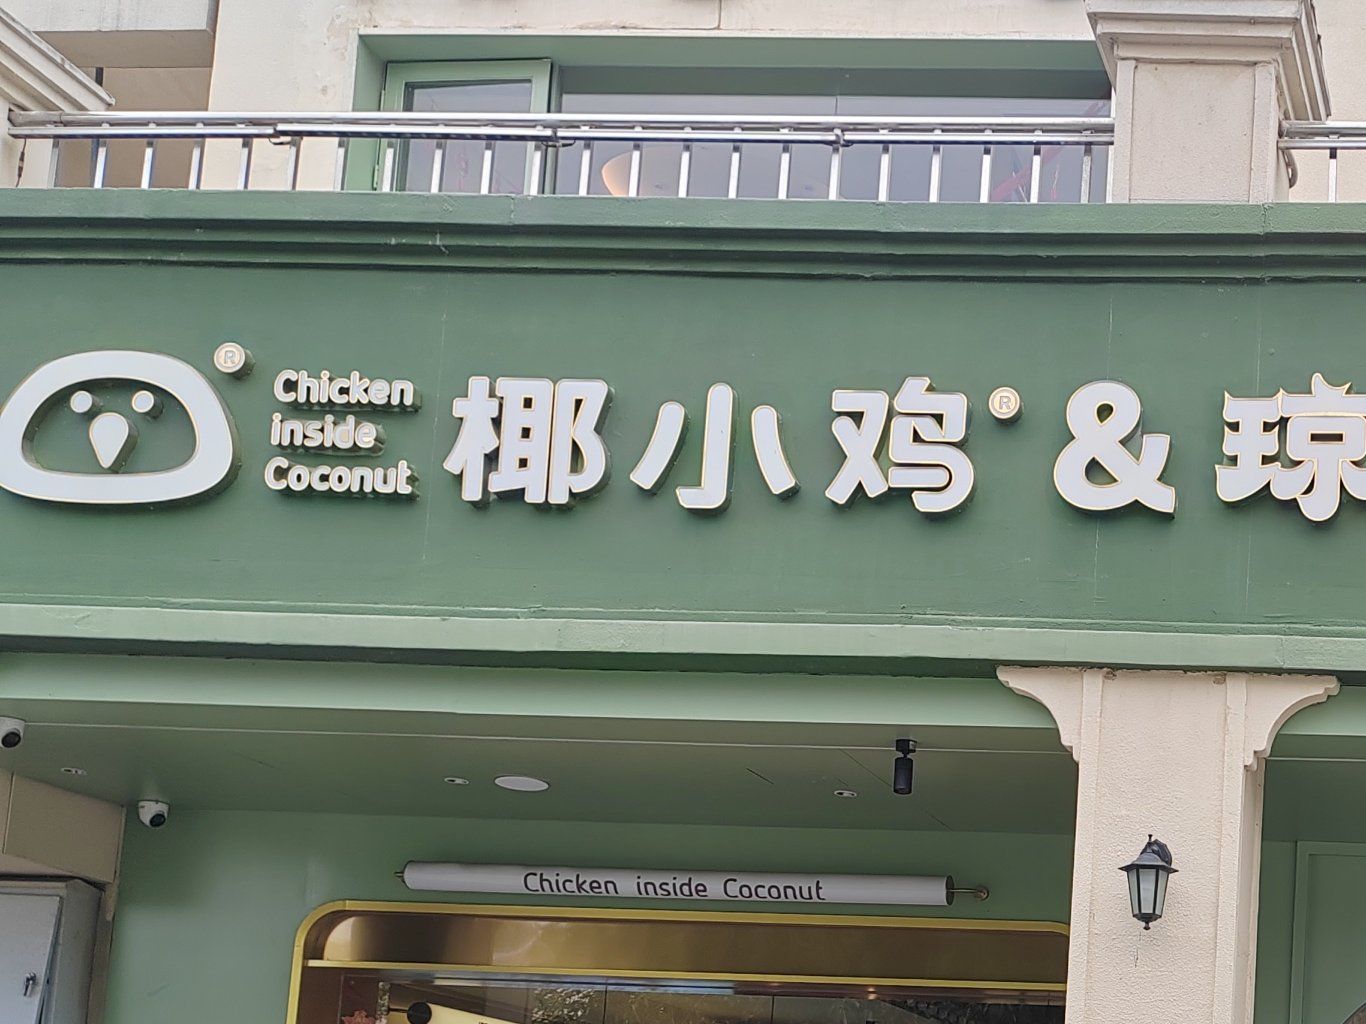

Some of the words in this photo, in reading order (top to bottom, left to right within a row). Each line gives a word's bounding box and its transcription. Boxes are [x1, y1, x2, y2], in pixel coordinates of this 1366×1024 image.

[273, 370, 414, 407] Chicken
[271, 412, 377, 449] inside
[1053, 379, 1176, 516] &
[264, 456, 413, 495] Coconut
[523, 872, 618, 895] Chicken
[636, 875, 708, 898] inside
[723, 878, 826, 902] Coconut
